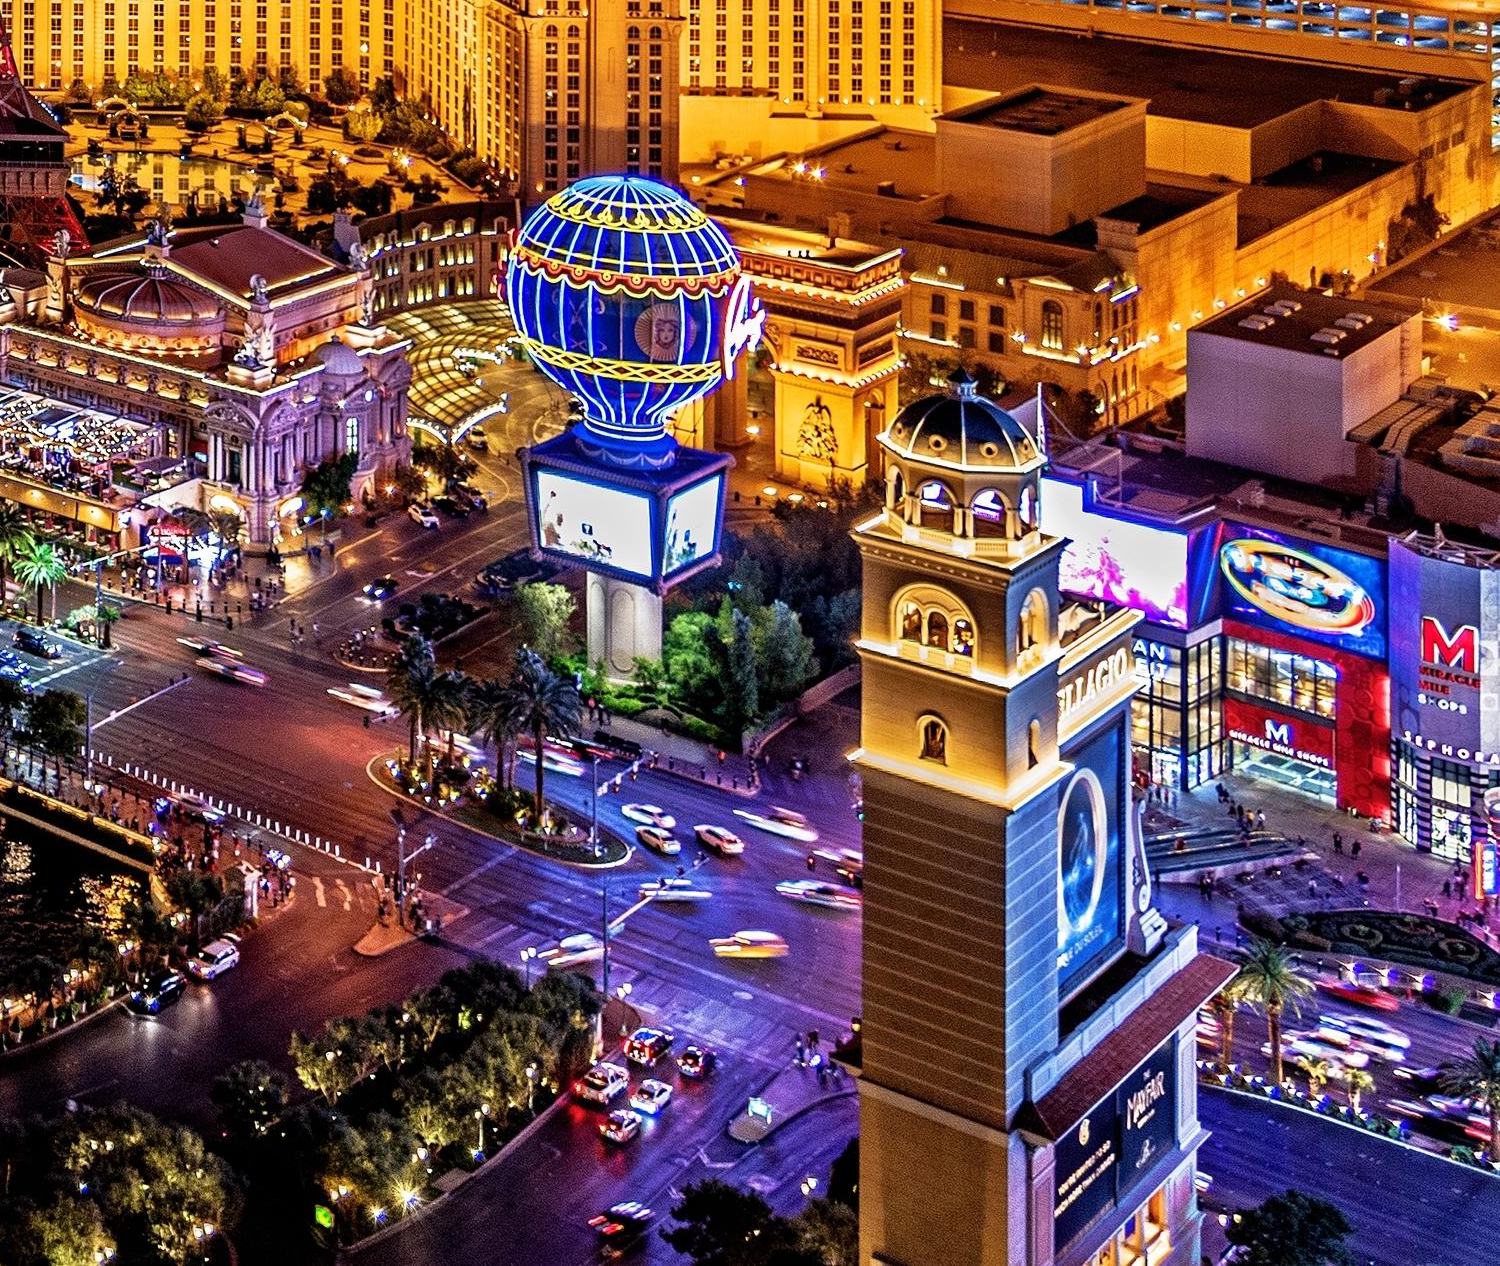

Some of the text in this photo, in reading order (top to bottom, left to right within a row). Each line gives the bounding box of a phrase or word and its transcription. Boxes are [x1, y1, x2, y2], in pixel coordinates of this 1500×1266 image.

[1421, 616, 1479, 675] M
[1057, 647, 1127, 714] LLAGIO
[1418, 680, 1450, 696] MILE
[1419, 665, 1480, 689] MIRACLE
[1418, 693, 1467, 715] SHOPS
[1229, 729, 1328, 767] MIRACLE MILE SHOPS
[1265, 719, 1288, 744] M
[1402, 730, 1500, 765] SEPHORA
[1126, 1071, 1165, 1130] MAYFAIR
